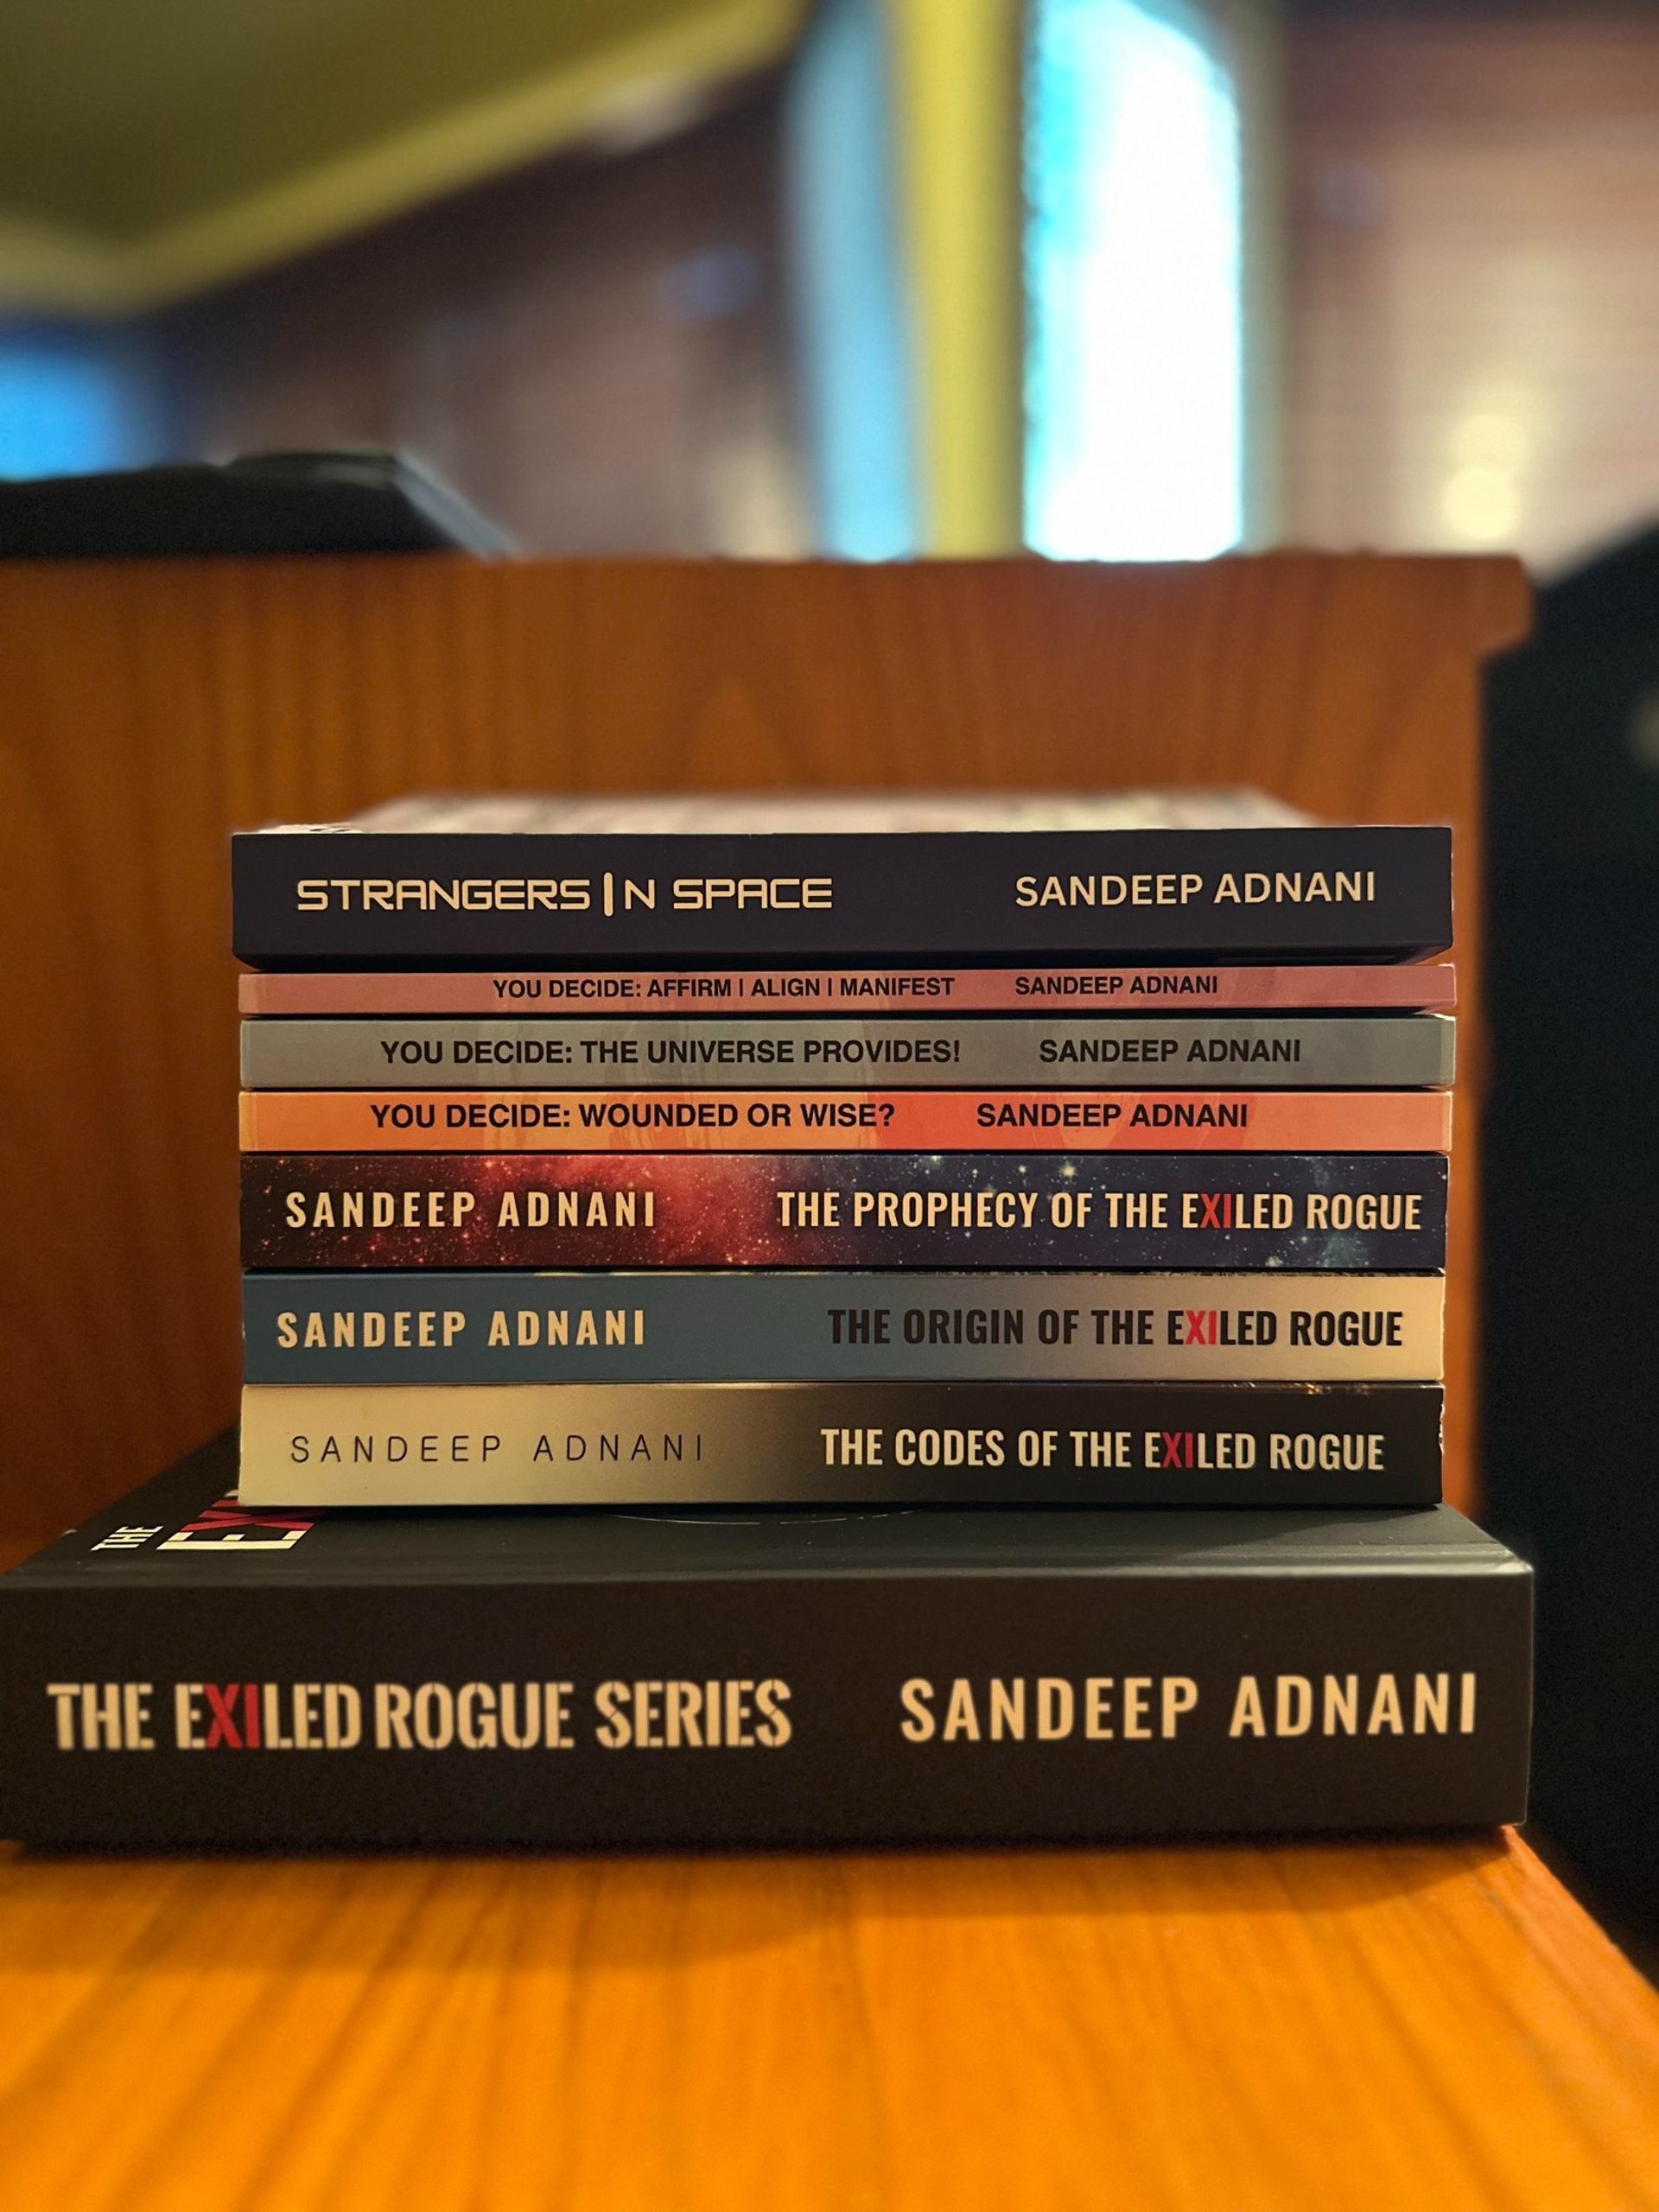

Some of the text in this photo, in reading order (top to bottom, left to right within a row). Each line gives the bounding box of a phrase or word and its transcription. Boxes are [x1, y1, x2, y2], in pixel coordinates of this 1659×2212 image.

[298, 880, 590, 910] STRANGERS
[674, 879, 831, 909] SPACE
[1016, 872, 1374, 906] SANDEEP ADNANI
[493, 980, 541, 998] YOU
[547, 979, 641, 998] DECIDE:
[647, 978, 731, 997] AFFIRM
[751, 978, 820, 996] ALIGN
[841, 977, 955, 995] MANIFEST
[1016, 976, 1217, 995] SANDEEP ADNANI
[381, 1039, 959, 1064] YOU DECIDE: THE UNIVERSE PROVIDES!
[1040, 1039, 1300, 1062] SANDEEP ADNANI
[371, 1103, 894, 1128] YOU DECIDE: WOUNDED OR WISE?
[977, 1103, 1247, 1127] SANDEEP ADNANI
[287, 1192, 653, 1227] SANDEEP ADNANI
[777, 1192, 1421, 1230] THE PROPHECY OF THE EXILED ROGUE
[278, 1310, 643, 1348] SANDEEP ADNANI
[828, 1309, 1402, 1346] THE ORIGIN OF THE EXILED ROGUE
[291, 1434, 701, 1463] SANDEEP ADNANI
[821, 1429, 1383, 1470] THE CODES OF THE EXILED ROGUE
[90, 1525, 164, 1551] THE
[48, 1680, 791, 1749] THE EXILED ROGUE SERIES
[901, 1674, 1475, 1741] SANDEEP ADNANI
